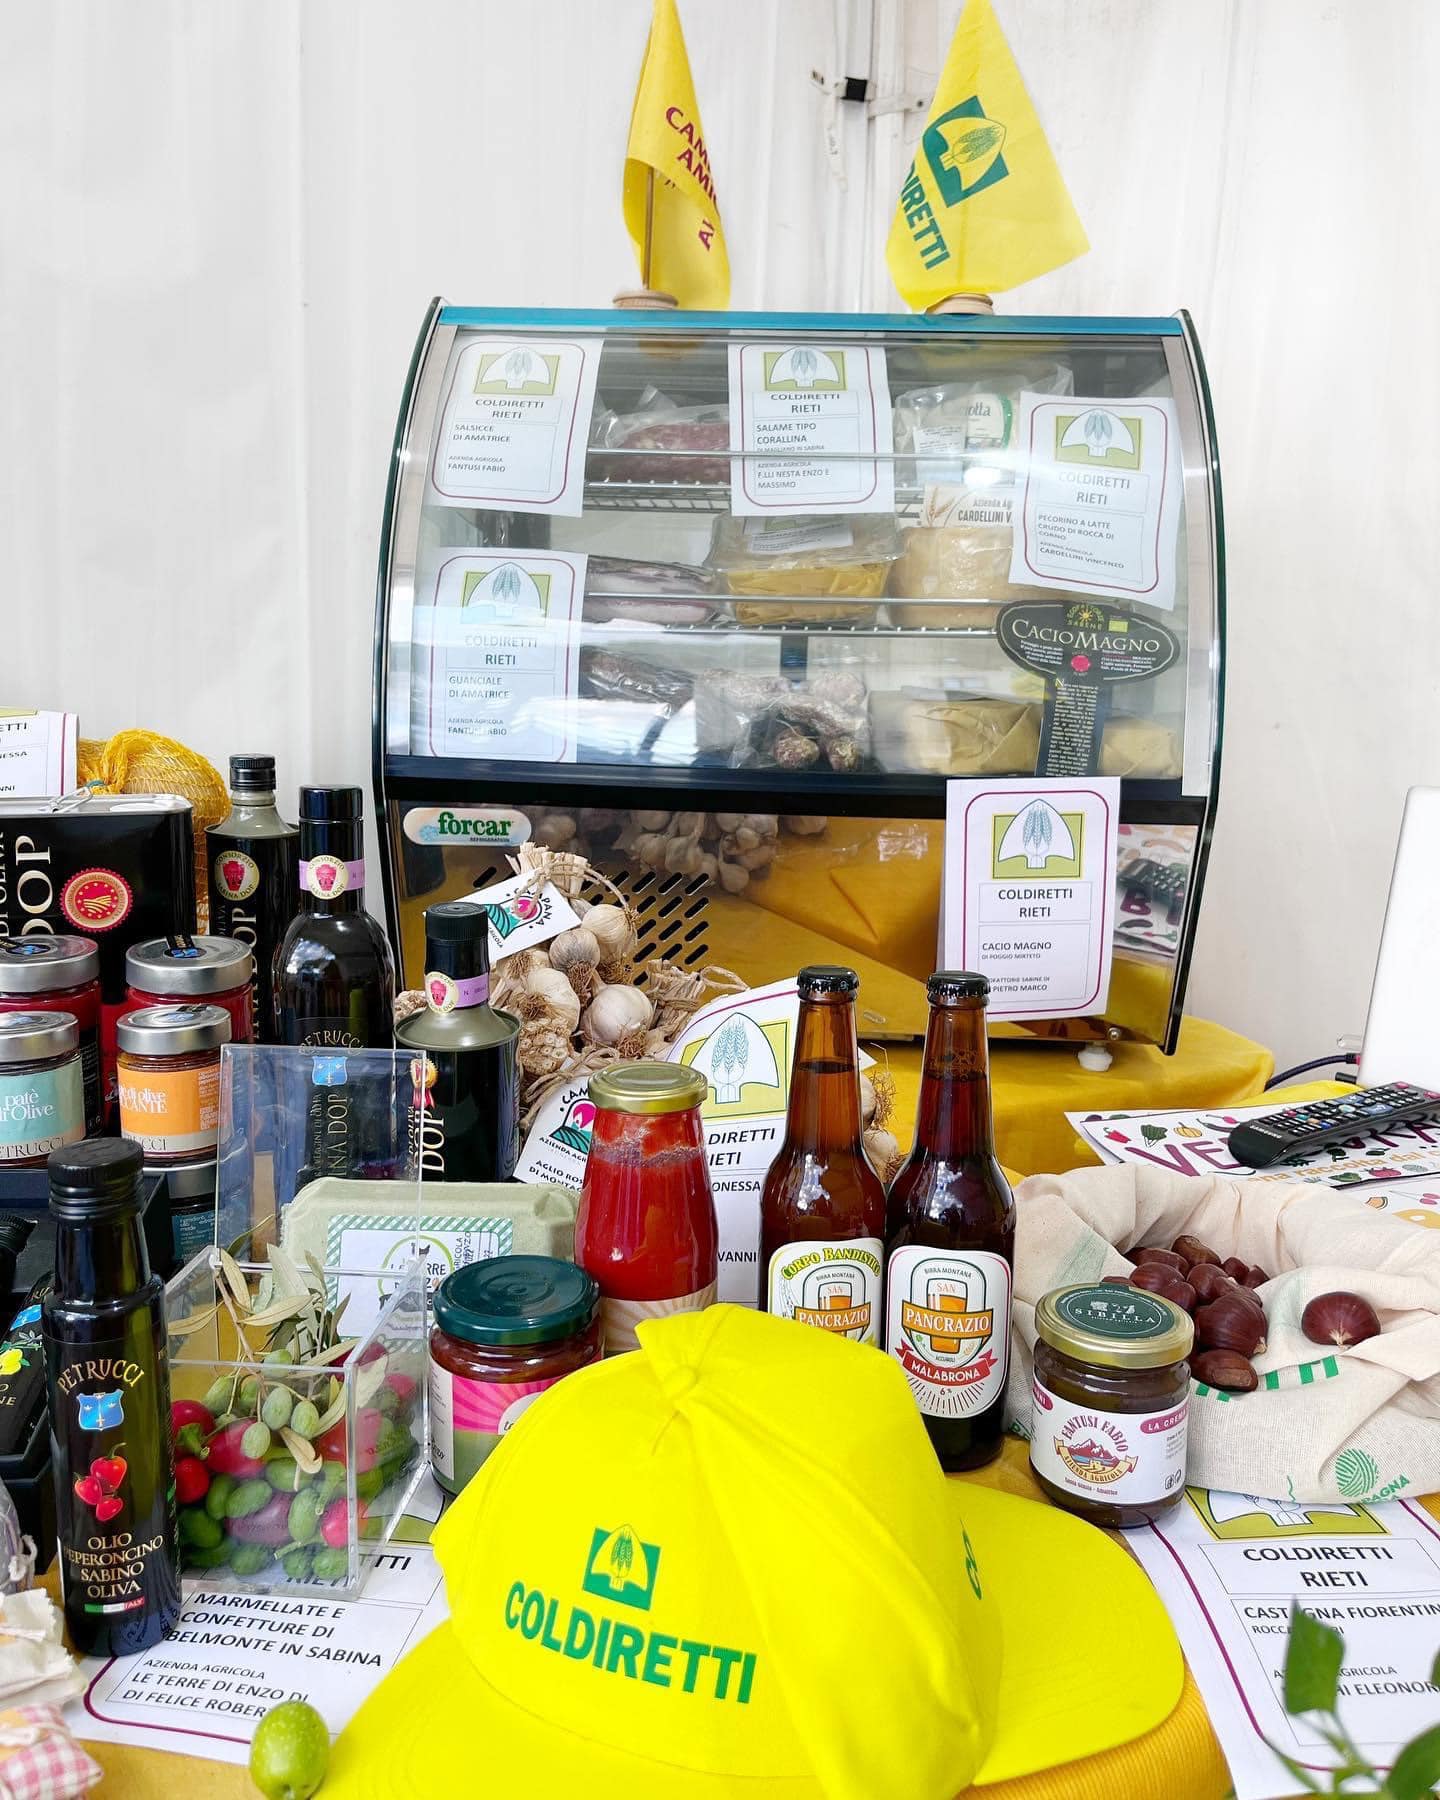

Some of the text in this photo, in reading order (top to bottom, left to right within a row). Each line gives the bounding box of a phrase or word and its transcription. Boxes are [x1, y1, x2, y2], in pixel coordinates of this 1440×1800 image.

[665, 106, 711, 175] CAM
[676, 147, 720, 217] AMI
[475, 398, 545, 409] COLDIRETTI
[791, 404, 821, 414] RIETI
[492, 410, 522, 419] RIETI
[455, 424, 494, 432] SALSICCE
[756, 422, 817, 432] SALAME TIPO
[453, 433, 511, 443] DI AMATRICE
[757, 435, 807, 444] CORALLINA
[448, 463, 506, 473] FANTUSI FABIO
[776, 469, 801, 478] NESTA
[802, 469, 824, 477] ENZO
[757, 481, 796, 489] MASSIMO
[1058, 470, 1131, 490] COLDIRETTI
[1076, 490, 1107, 505] RIETI
[958, 510, 1004, 522] CARDELLINI
[1038, 514, 1111, 530] PECORINO A LATTE
[1038, 523, 1115, 540] CRUDO DI ROCCA DI
[1039, 546, 1125, 569] CARDELLINI VINCENZO
[464, 635, 538, 649] COLDIRETTI
[485, 654, 516, 665] RIETI
[449, 676, 502, 686] GUANCIALE
[449, 689, 510, 699] DI AMATRICE
[438, 811, 513, 836] forcar
[998, 888, 1074, 901] COLDIRETTI
[1019, 906, 1051, 918] RIETI
[982, 941, 1052, 951] CACIO MAGNO
[1019, 984, 1048, 992] MARCO
[562, 1087, 588, 1104] CAM
[11, 1103, 54, 1121] Olive
[327, 1093, 348, 1134] DOP
[708, 1128, 775, 1146] DIRETTI
[1250, 1124, 1283, 1139] SAMSUNG
[0, 1136, 64, 1158] TRUCCI
[415, 1109, 445, 1173] DOP
[539, 1136, 571, 1156] AZIENDA
[709, 1152, 741, 1167] IETI
[1295, 1157, 1383, 1177] raccolta
[1391, 1152, 1425, 1162] dal
[529, 1166, 539, 1176] DI
[535, 1160, 563, 1177] AGLIO
[711, 1180, 761, 1192] ONESSA
[454, 1237, 463, 1270] RICOLA
[718, 1251, 757, 1264] VANNI
[782, 1254, 821, 1280] CORPO
[941, 1268, 972, 1281] MONTANA
[827, 1286, 844, 1294] SAN
[936, 1282, 957, 1293] SAN
[799, 1309, 869, 1328] PANCRAZIO
[905, 1307, 990, 1333] PANCRAZIO
[1074, 1308, 1156, 1324] SIBILLA
[57, 1359, 145, 1395] PETRUCCI
[911, 1359, 981, 1383] MALABRONA
[1061, 1415, 1098, 1441] FANTUSI
[1101, 1421, 1129, 1452] FABIO
[1148, 1423, 1160, 1431] LA
[1064, 1455, 1123, 1482] AZIENDA AGRICOLA
[87, 1532, 132, 1550] OLIO
[1243, 1546, 1393, 1563] COLDIRETTI
[80, 1562, 144, 1582] SABINO
[1300, 1571, 1368, 1587] RIETI
[87, 1580, 142, 1599] OLIVA
[194, 1593, 346, 1619] MARMELLATE E
[1244, 1603, 1440, 1620] CASTGNA FIORENTIN
[180, 1611, 309, 1637] CONFETTURE
[312, 1625, 335, 1638] DI
[164, 1630, 382, 1667] BELMONTE IN SABINA
[504, 1581, 757, 1704] COLDIRETTI
[143, 1658, 265, 1680] AZIENDA AGRICOLA
[131, 1673, 309, 1704] LE TERRE DI ENZO DI
[1351, 1682, 1440, 1696] ELEONOR
[123, 1689, 271, 1718] DI FELICE ROBER
